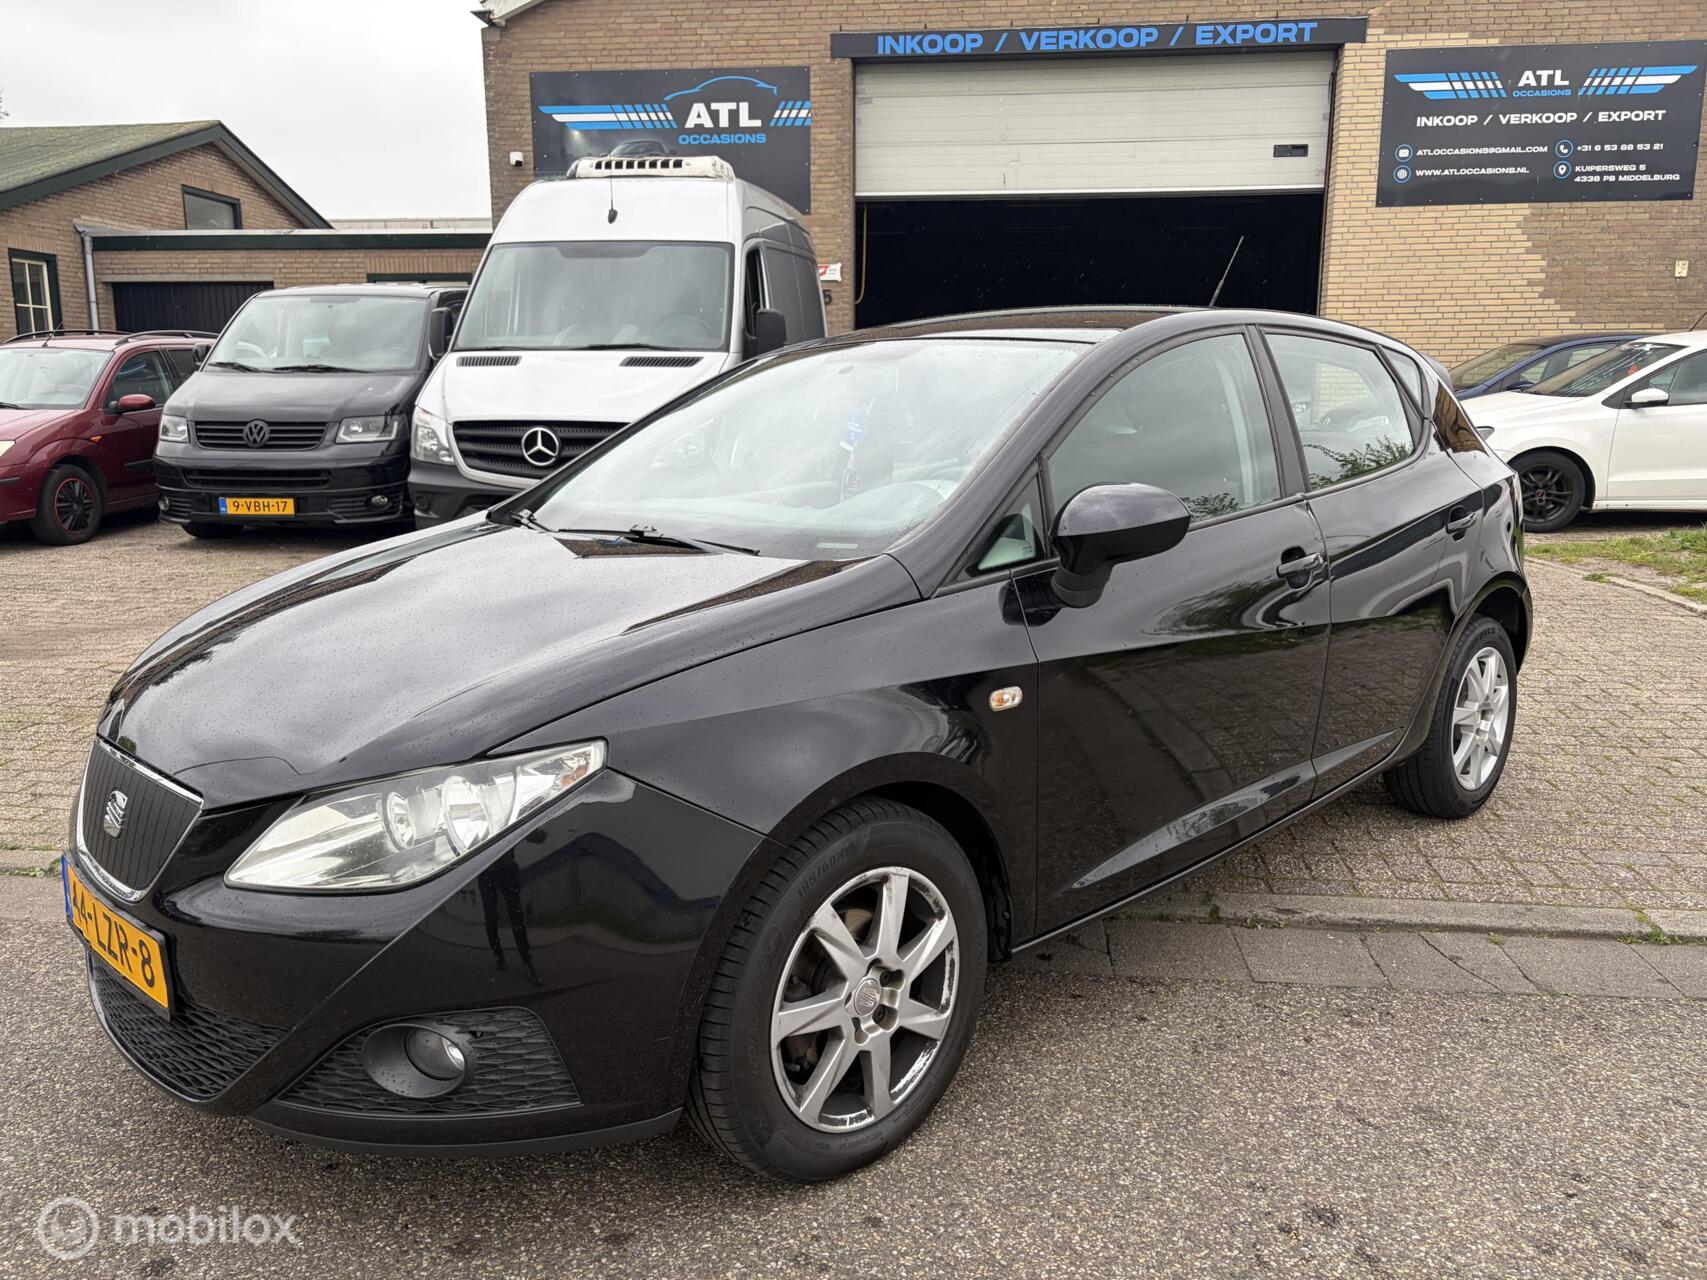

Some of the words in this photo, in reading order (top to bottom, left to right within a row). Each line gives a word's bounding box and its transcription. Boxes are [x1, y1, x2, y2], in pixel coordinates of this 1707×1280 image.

[877, 33, 984, 55] INKOOP
[994, 34, 1007, 52] /
[1019, 28, 1160, 52] VERKOOP
[1169, 27, 1184, 46] /
[1195, 22, 1318, 46] EXPORT
[1517, 69, 1570, 88] ATL
[1512, 88, 1572, 98] OCCASIONS
[684, 102, 762, 128] ATL
[1416, 115, 1478, 128] INKOOP
[1483, 114, 1494, 126] /
[1499, 112, 1577, 125] VERKOOP
[1582, 111, 1592, 123] /
[1597, 109, 1667, 123] EXPORT
[678, 133, 767, 145] OCCASIONS
[1576, 144, 1592, 152] +31
[1594, 144, 1602, 152] 6
[1603, 143, 1618, 152] 53
[1636, 143, 1651, 151] 53
[1652, 142, 1664, 150] 21
[1415, 166, 1530, 177] WWW.ATLOCCASIONS.NL
[1574, 164, 1637, 173] KUIPERSWEG
[1574, 175, 1601, 183] 4338
[1618, 173, 1681, 182] MIDDELBURG
[233, 501, 287, 512] 9-VBH-17
[72, 881, 155, 988] 44-LZR-8
